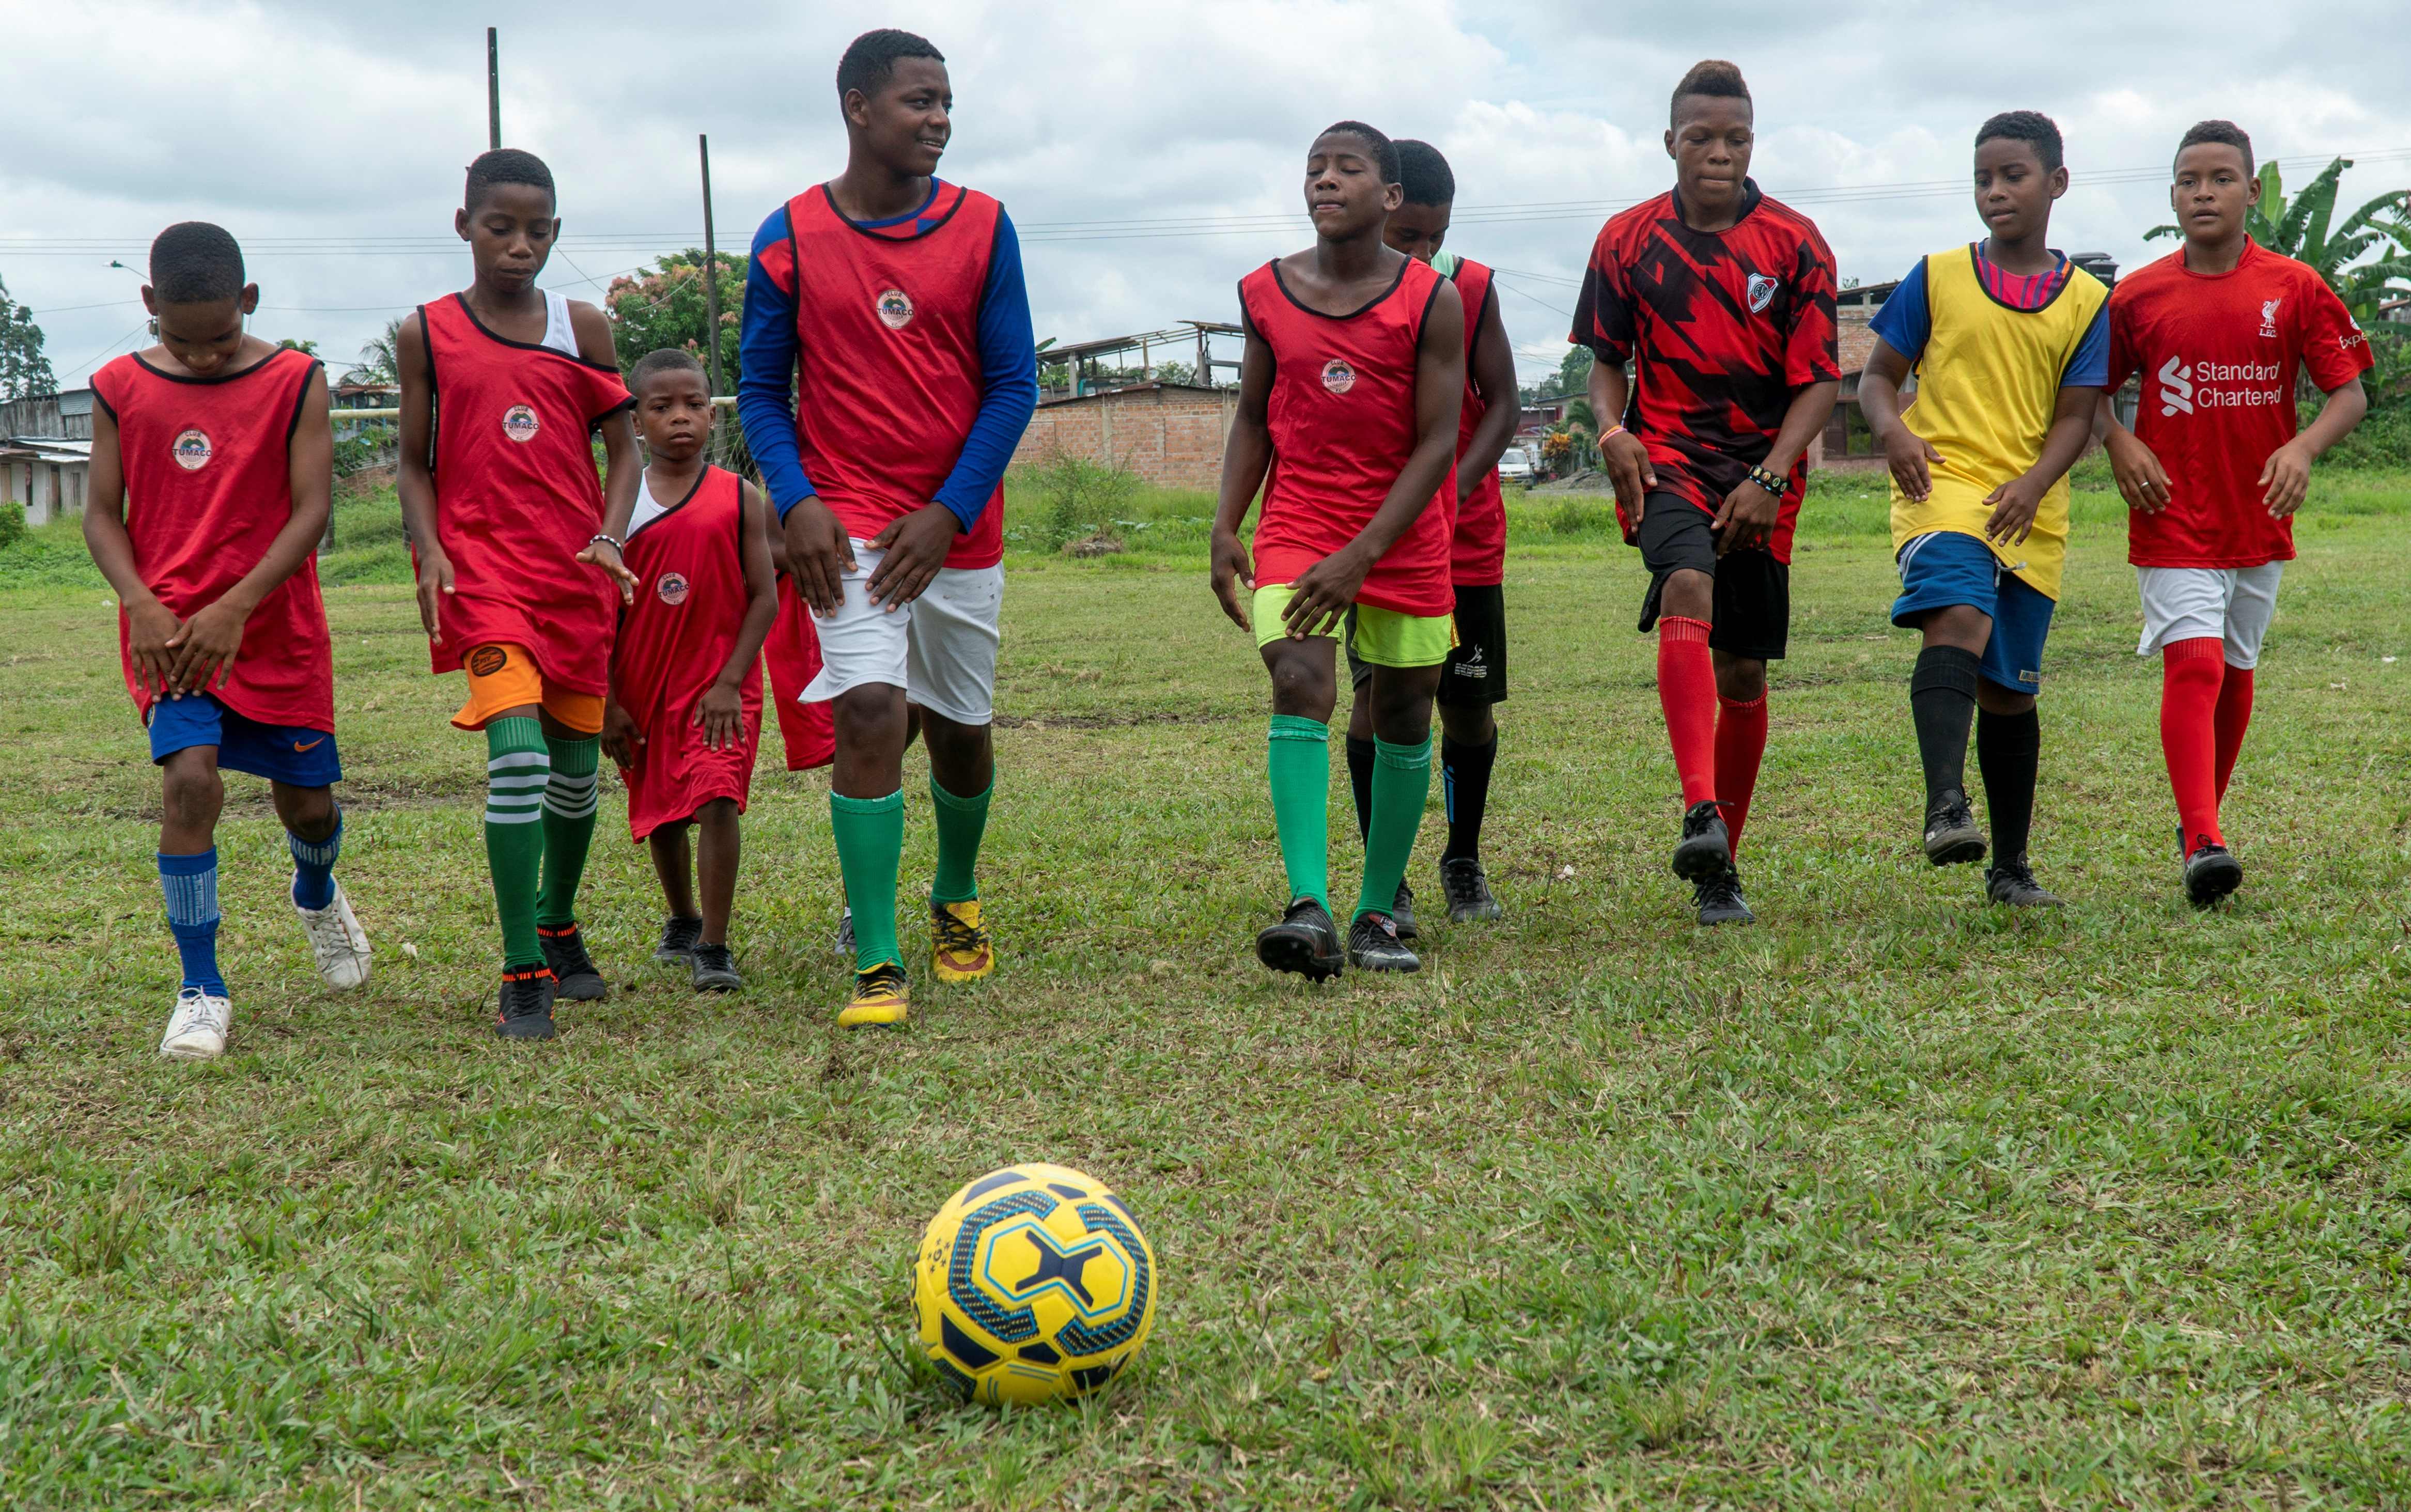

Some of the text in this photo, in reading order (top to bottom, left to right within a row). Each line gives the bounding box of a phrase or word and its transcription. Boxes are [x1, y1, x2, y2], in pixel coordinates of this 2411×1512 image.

[2197, 361, 2281, 382] Standard
[2198, 385, 2282, 408] Chartered
[657, 584, 690, 597] TUMACO
